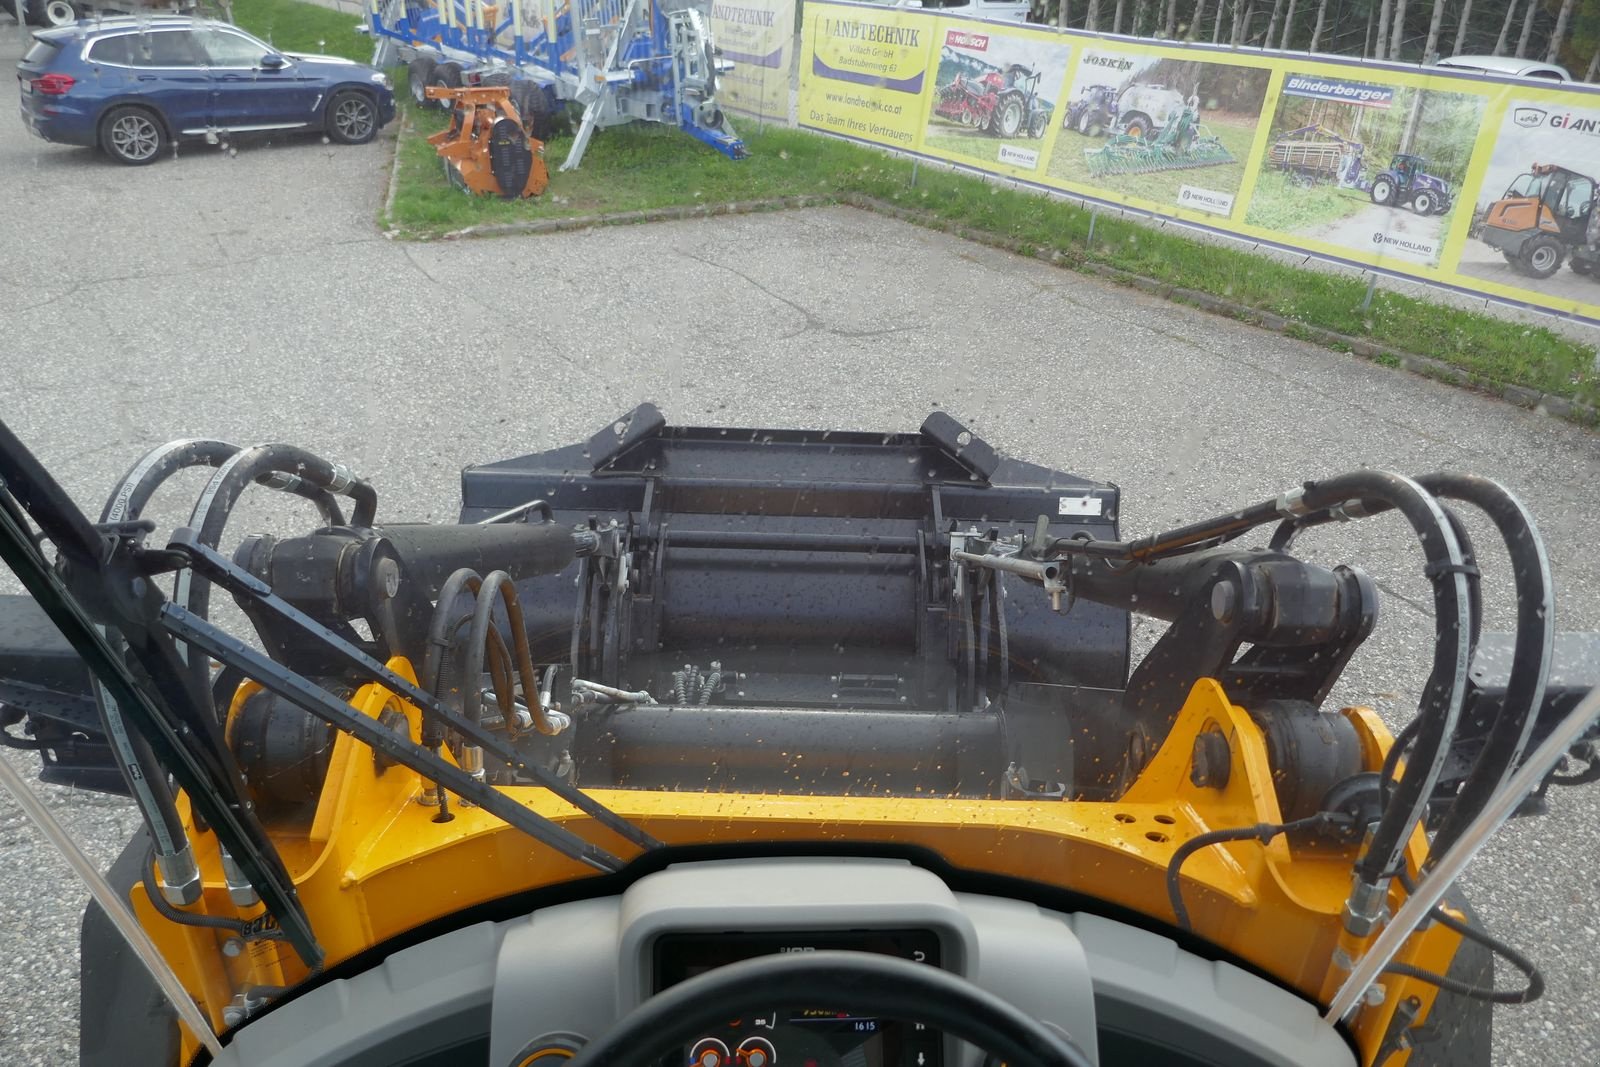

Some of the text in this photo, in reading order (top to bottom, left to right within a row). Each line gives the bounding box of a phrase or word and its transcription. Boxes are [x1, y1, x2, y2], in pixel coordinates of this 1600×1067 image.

[712, 4, 775, 28] ANDTECHNIK
[825, 18, 920, 48] LANDTECHNIK
[849, 44, 871, 55] Villach
[838, 56, 888, 73] Badstubenweg
[1083, 55, 1134, 70] JOSKIN
[1287, 78, 1391, 101] Binderberger
[826, 92, 902, 116] www.landtechik.co.at
[810, 110, 913, 142] Das Team Ihres Vertrauens
[1203, 196, 1229, 207] HOLLND
[1384, 236, 1399, 246] NEW
[1400, 240, 1432, 253] HOLLAND
